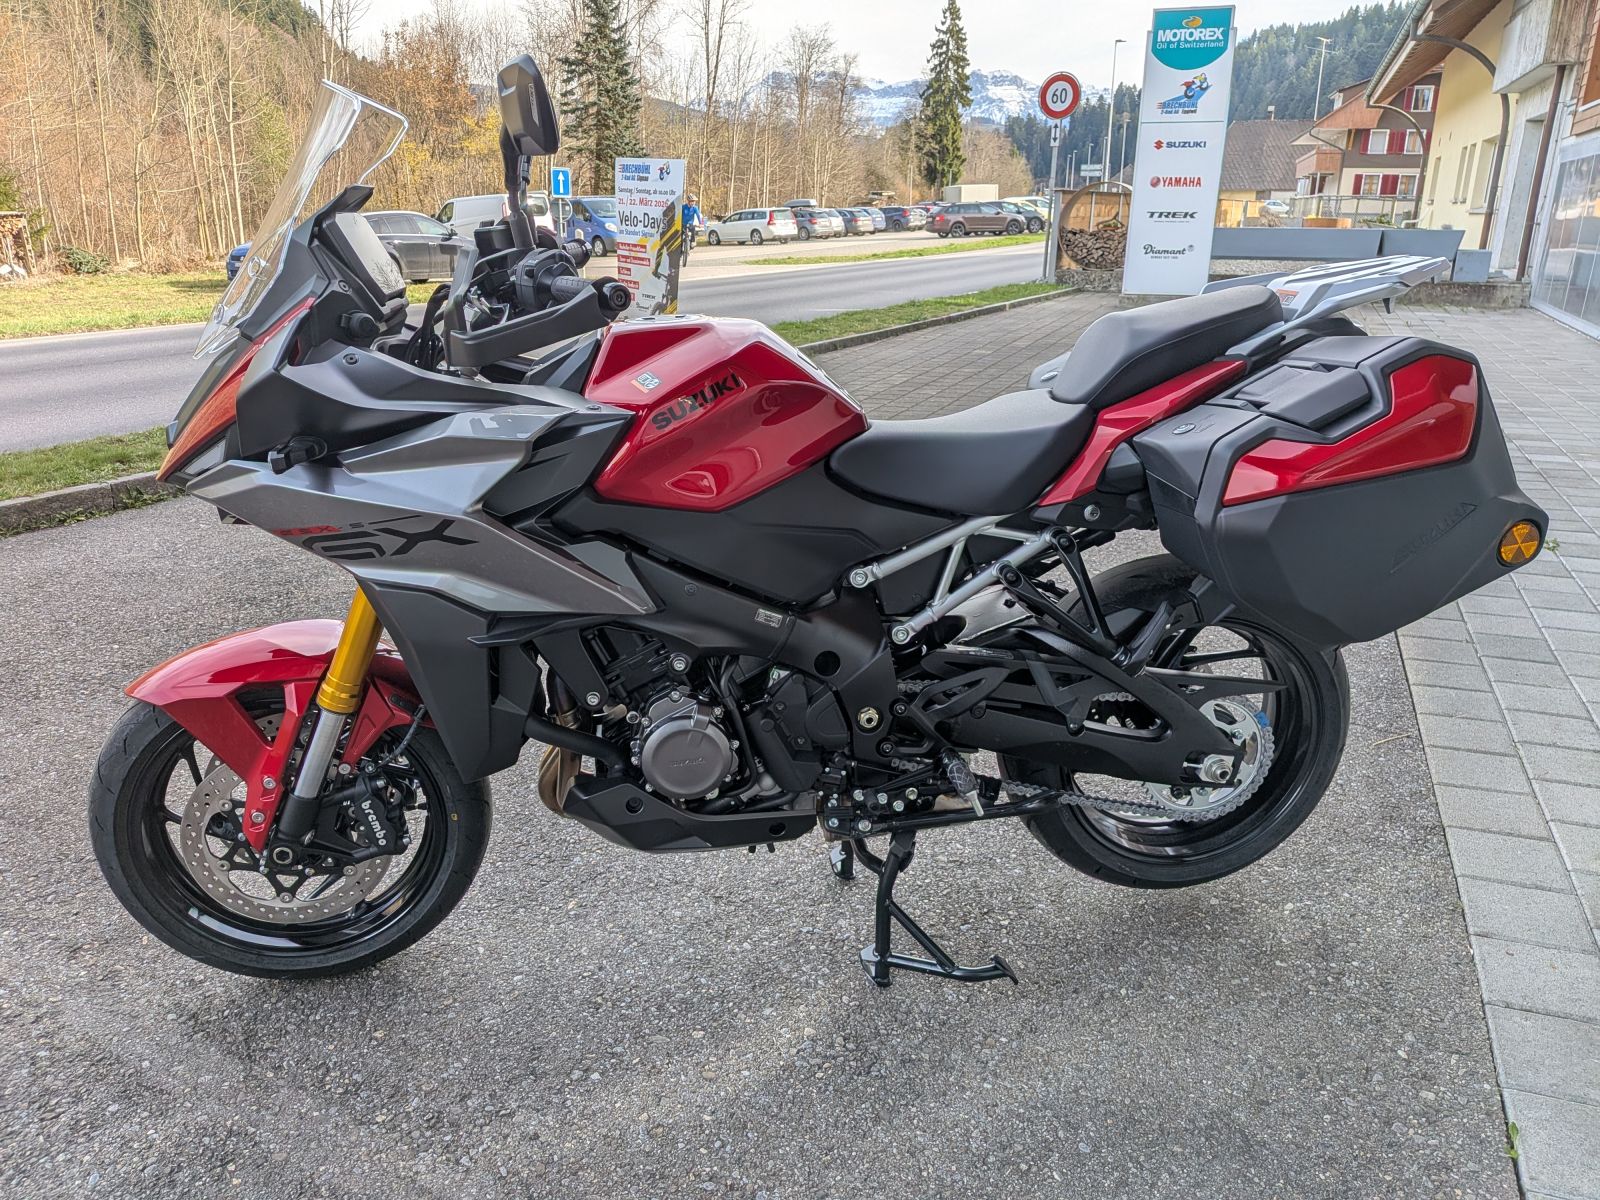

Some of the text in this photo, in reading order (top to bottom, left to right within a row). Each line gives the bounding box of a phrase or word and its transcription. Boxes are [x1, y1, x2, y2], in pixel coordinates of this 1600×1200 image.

[1157, 28, 1224, 42] MOTOREX
[1179, 41, 1224, 49] Switzerland
[1051, 88, 1067, 104] 60
[1165, 140, 1206, 149] SUZUKI
[1162, 176, 1202, 187] YAMAHA
[639, 196, 653, 207] März
[1146, 211, 1198, 219] TREK
[618, 210, 668, 234] Velo-Days
[1143, 243, 1187, 256] Diamant
[651, 371, 741, 431] SUZUKI
[361, 800, 387, 846] brembo
